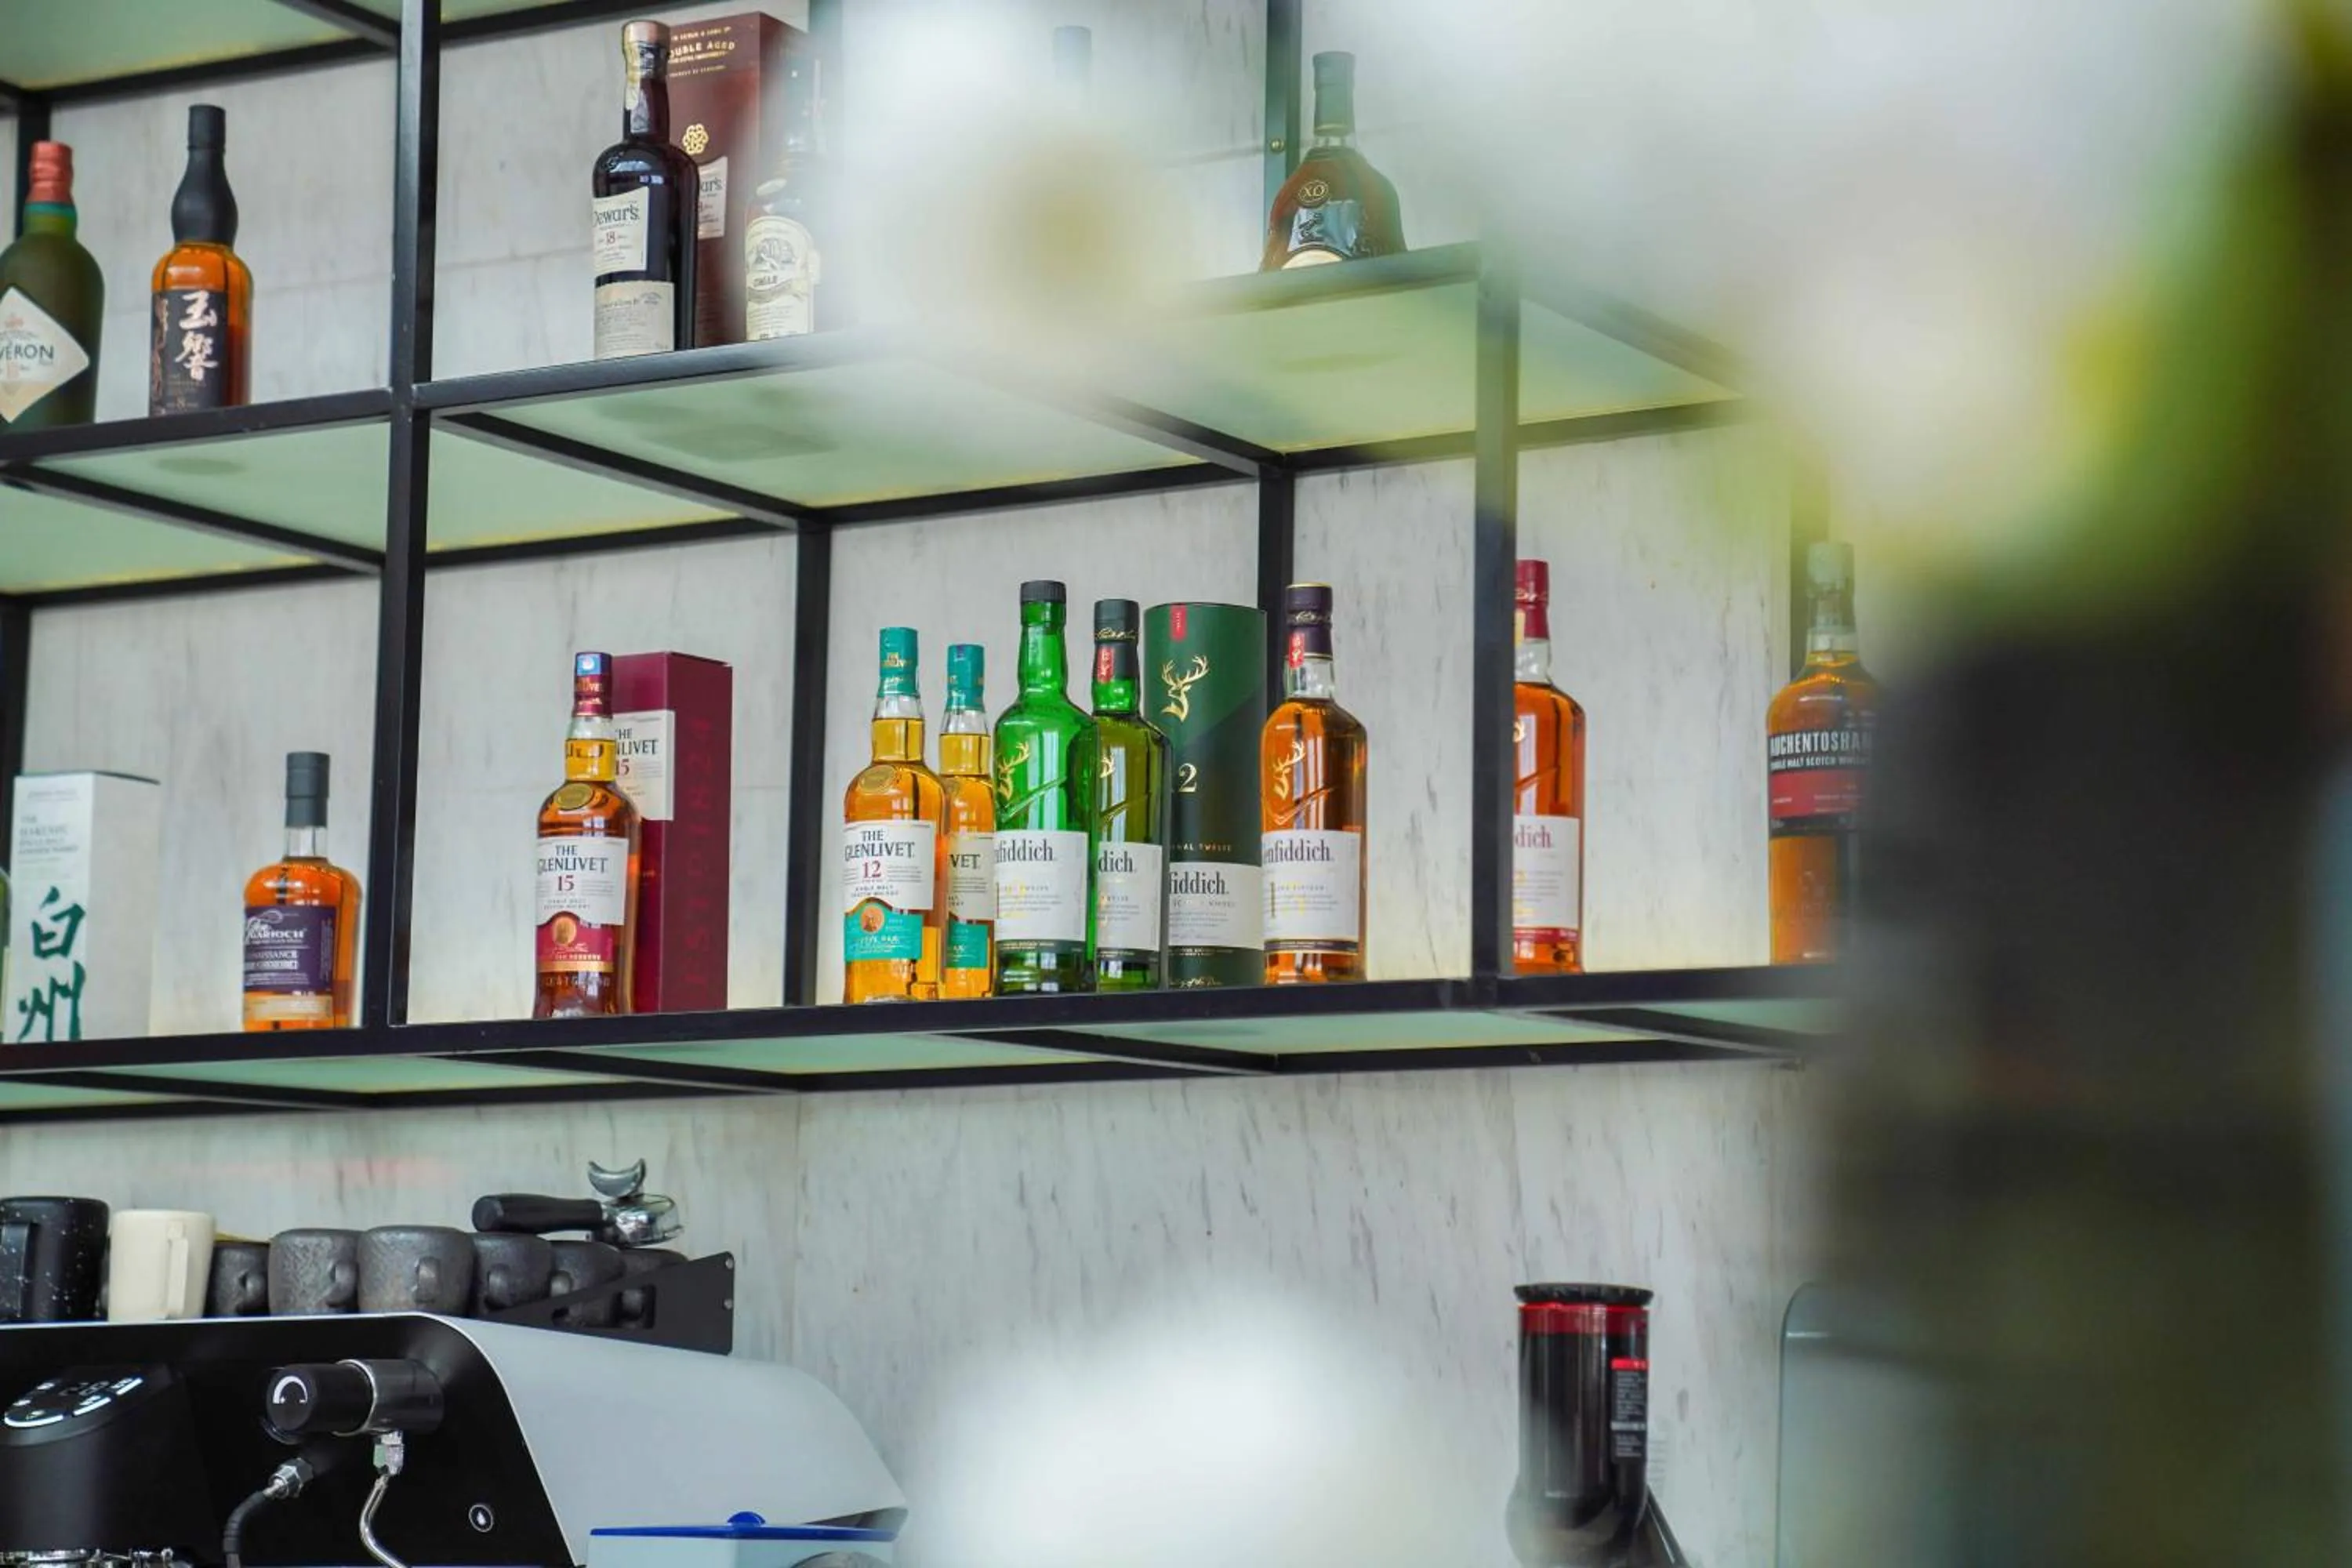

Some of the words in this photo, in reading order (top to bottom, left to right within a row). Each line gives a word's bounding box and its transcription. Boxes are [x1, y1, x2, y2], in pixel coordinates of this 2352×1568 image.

[1303, 183, 1325, 198] XO
[862, 829, 885, 842] THE
[555, 844, 579, 857] THE
[863, 860, 882, 879] 12
[557, 874, 575, 892] 15
[18, 885, 87, 1044] 白州
